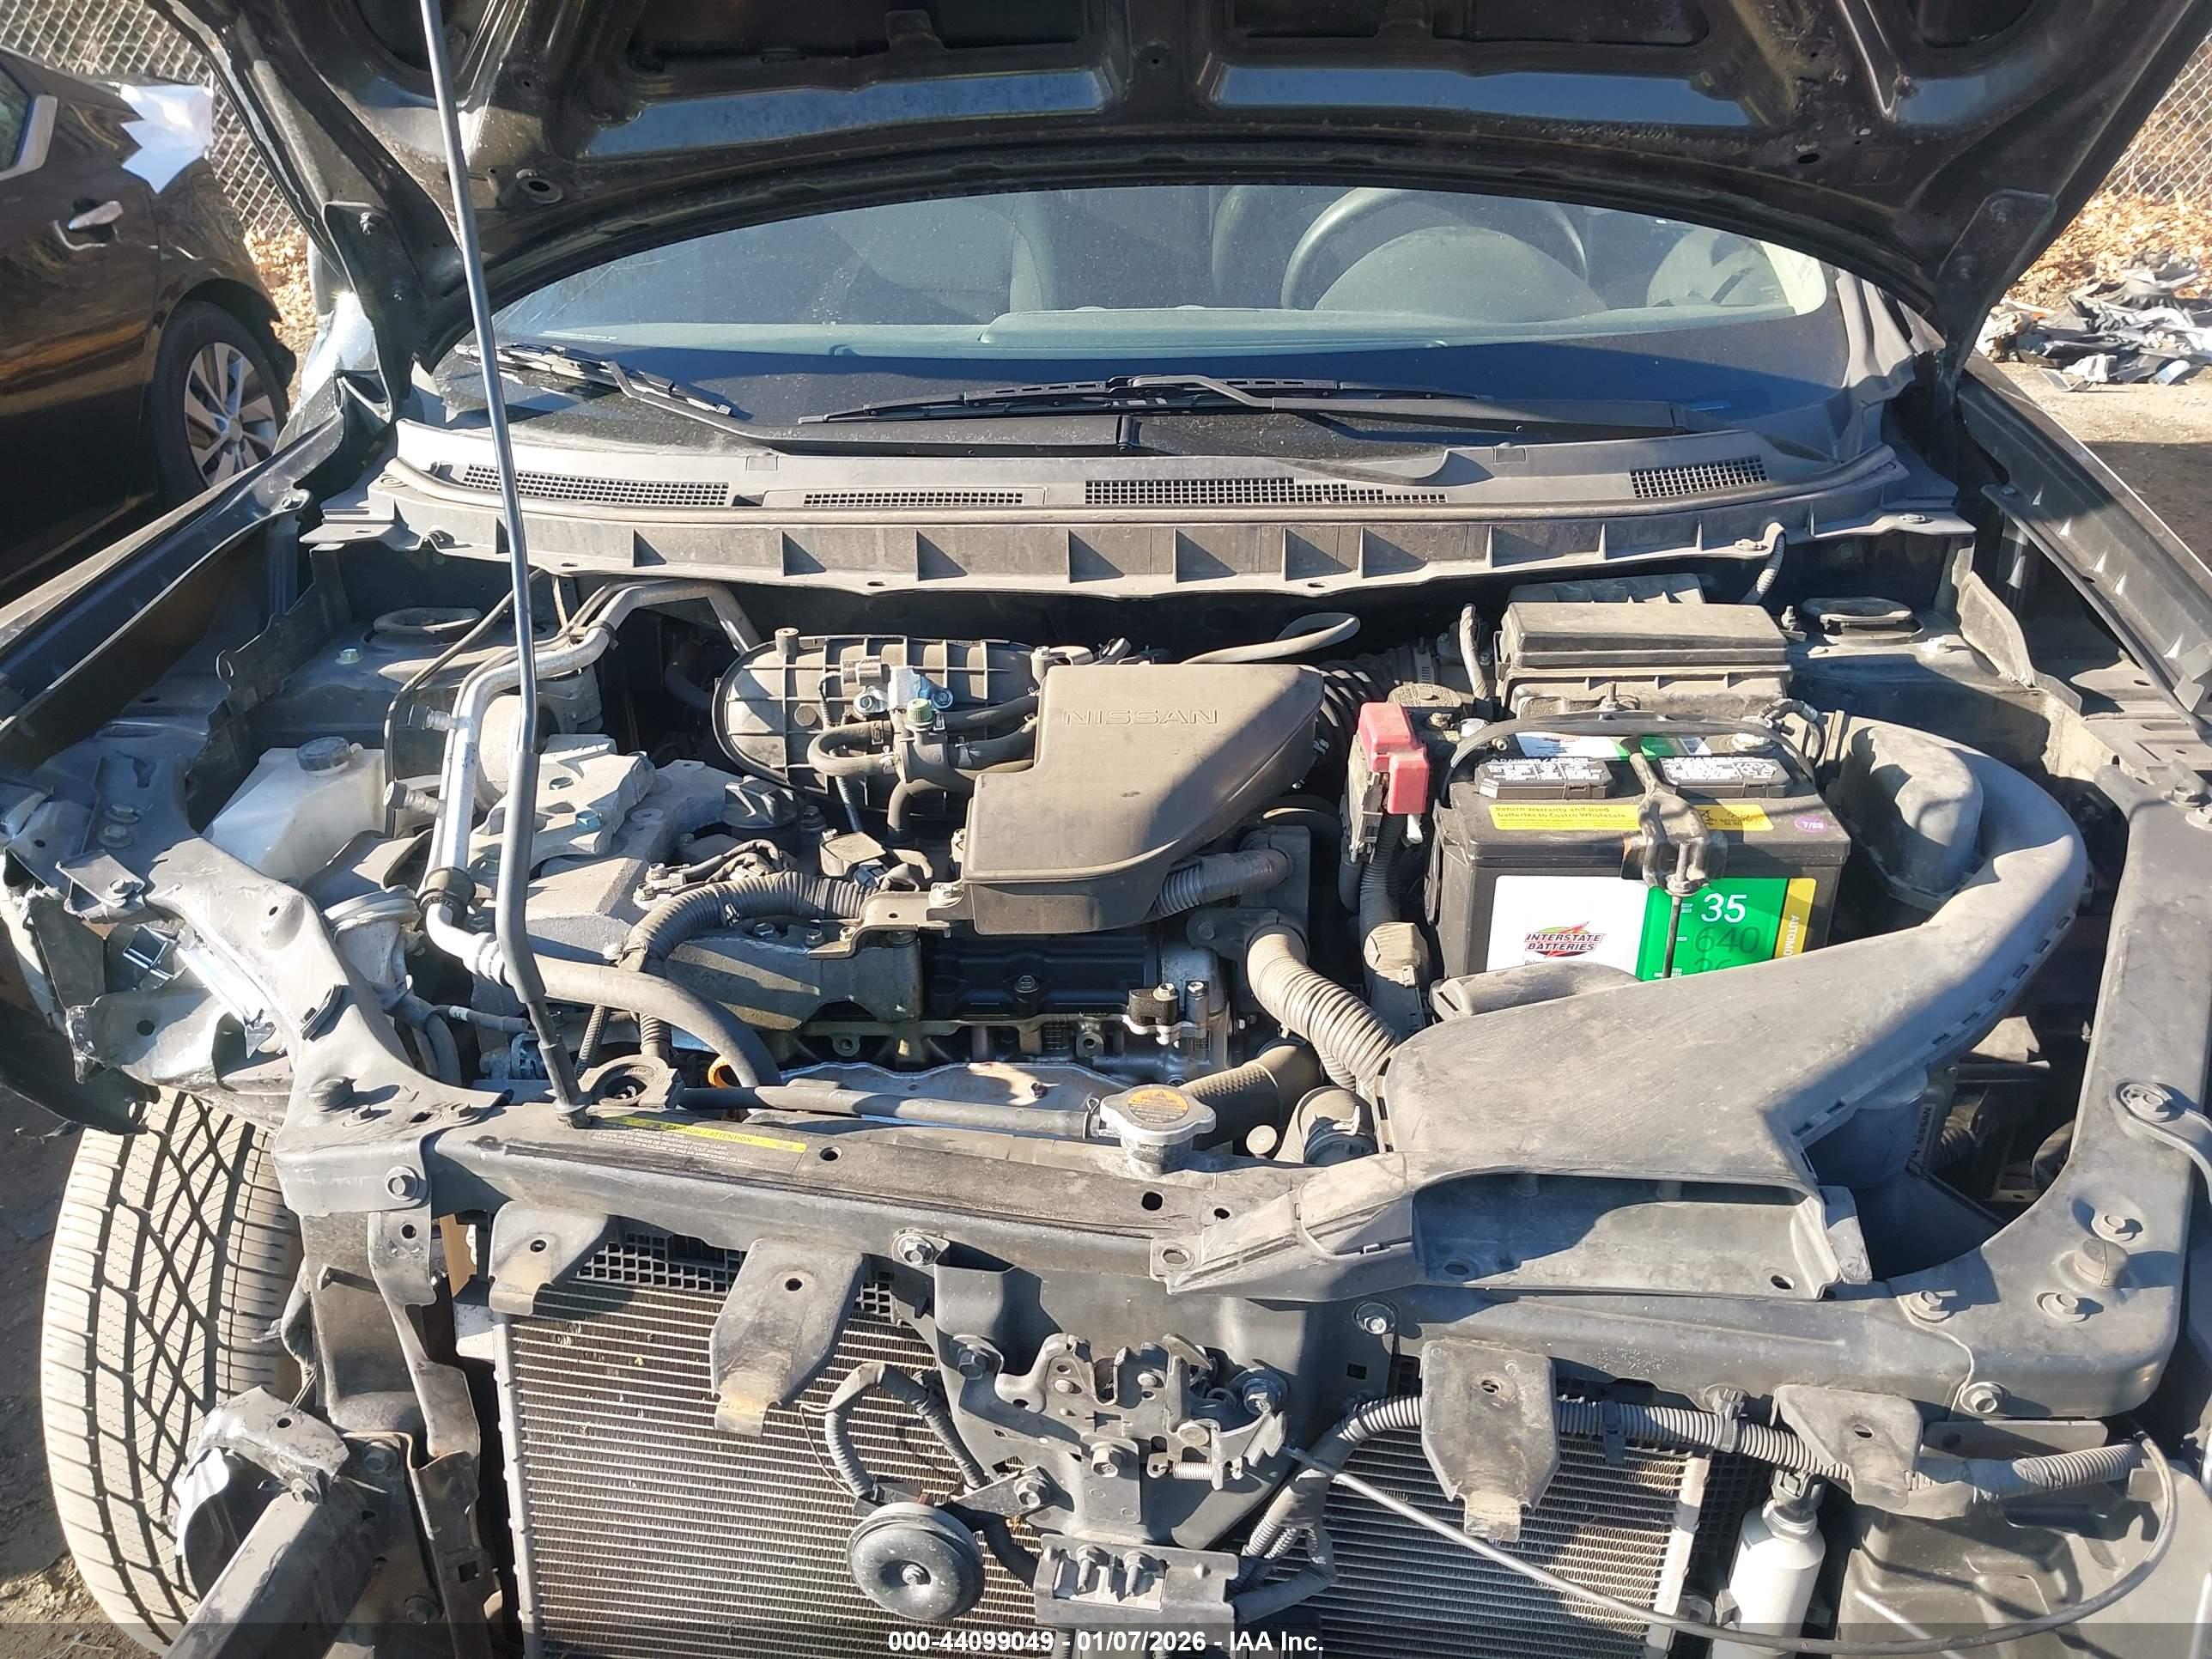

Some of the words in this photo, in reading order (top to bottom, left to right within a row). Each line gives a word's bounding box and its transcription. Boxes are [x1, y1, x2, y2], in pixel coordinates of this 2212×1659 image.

[1063, 709, 1218, 725] NISSAN
[1701, 892, 1747, 923] 35
[1526, 933, 1603, 942] INTERSTATE
[1693, 925, 1759, 954] 640
[708, 1131, 753, 1143] ATTENTION
